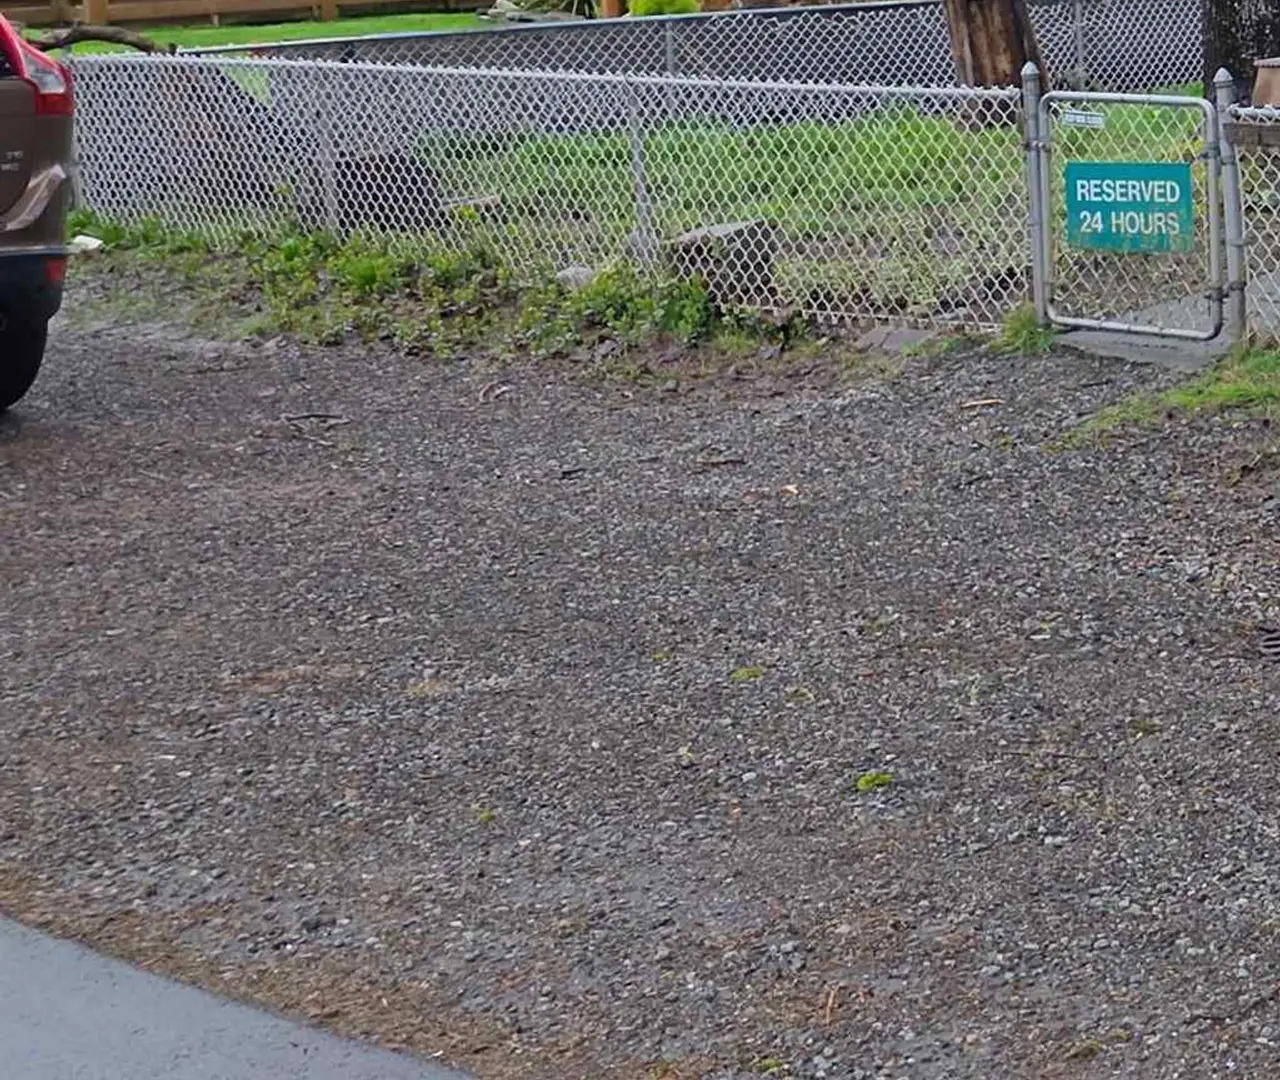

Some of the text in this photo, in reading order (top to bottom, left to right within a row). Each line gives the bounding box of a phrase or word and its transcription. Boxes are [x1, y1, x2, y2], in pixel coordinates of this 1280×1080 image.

[1076, 180, 1180, 203] RESERVED
[1080, 211, 1180, 235] 24 HOURS
